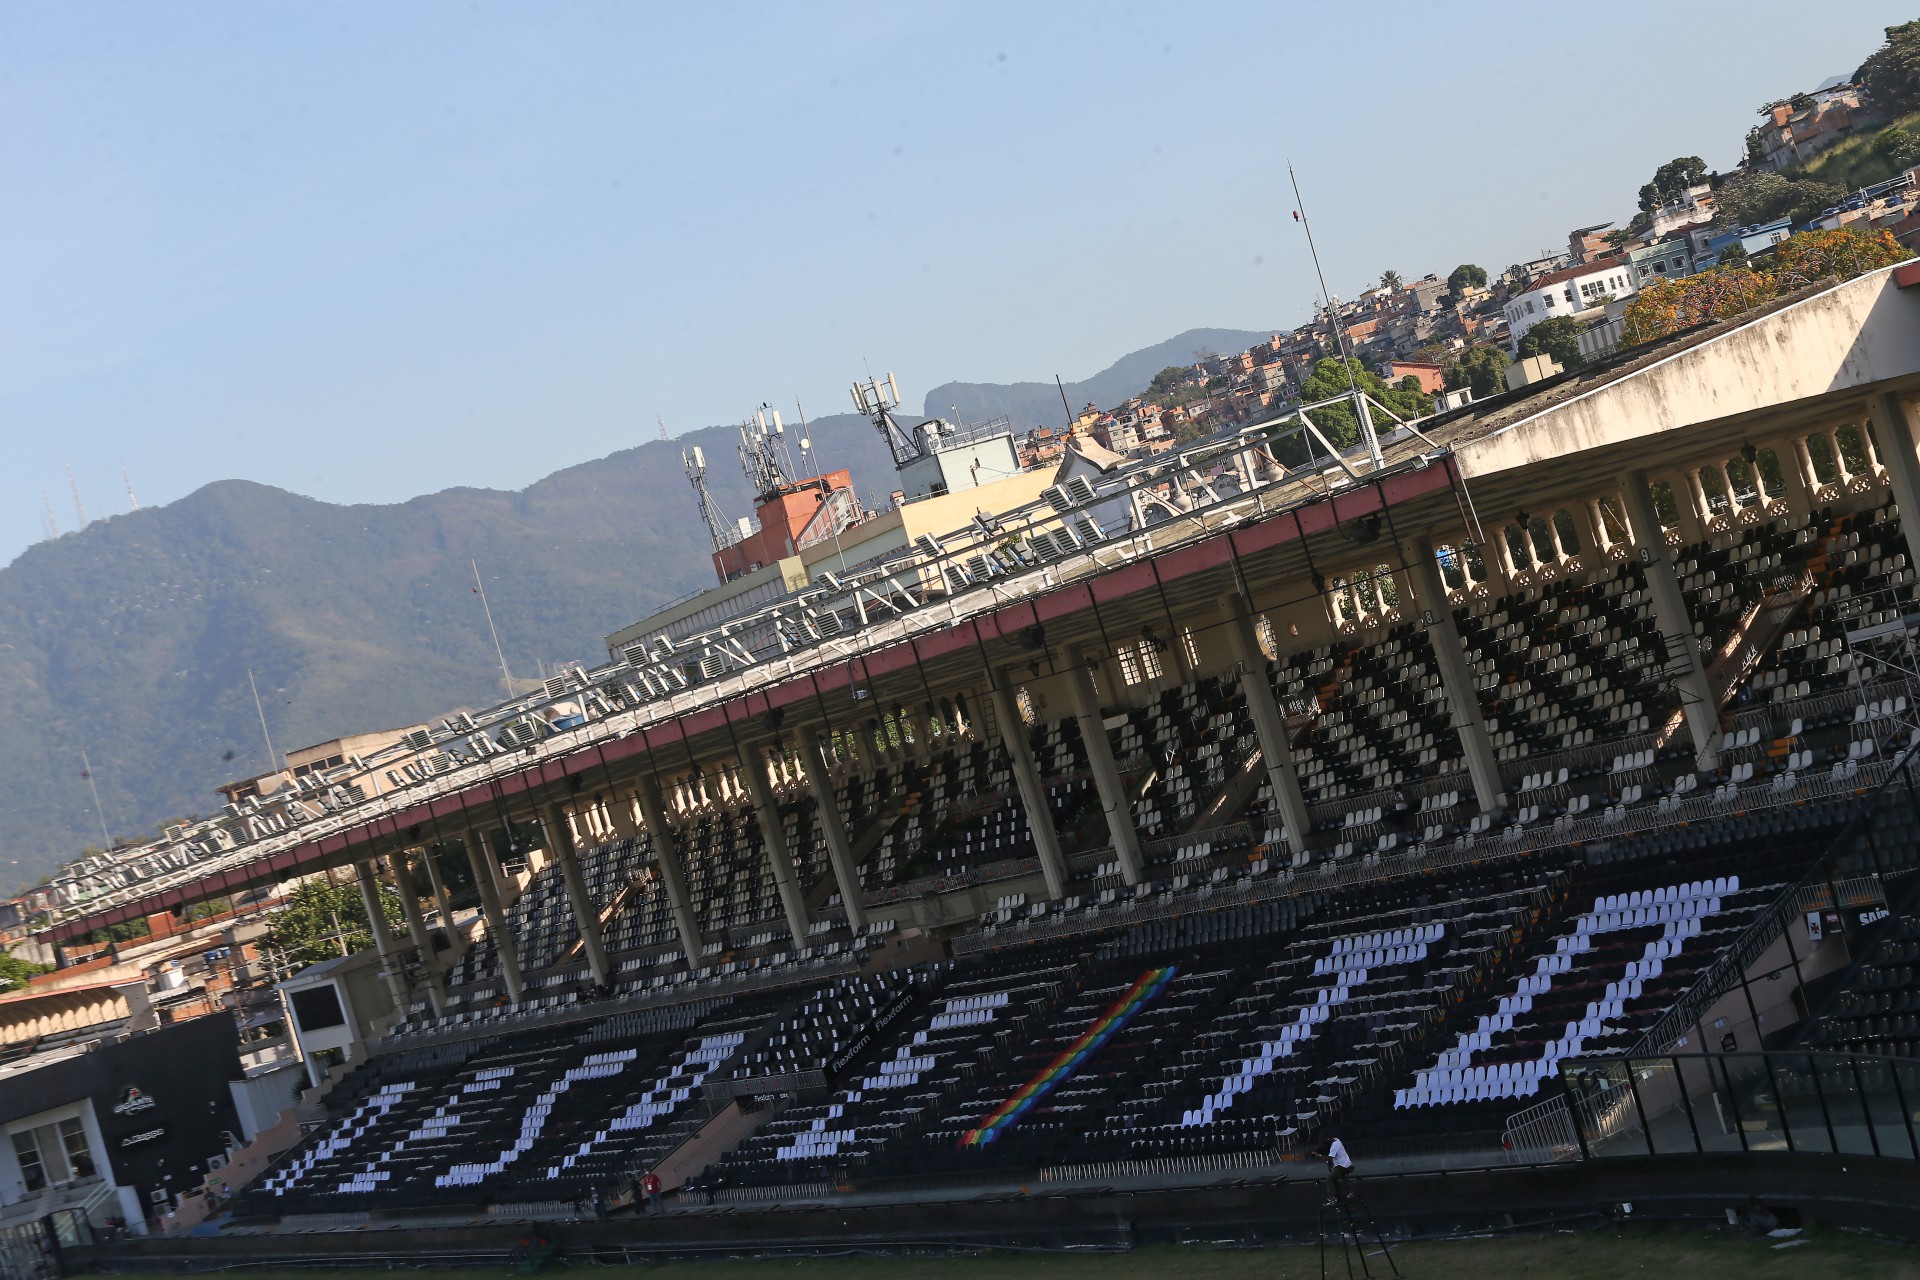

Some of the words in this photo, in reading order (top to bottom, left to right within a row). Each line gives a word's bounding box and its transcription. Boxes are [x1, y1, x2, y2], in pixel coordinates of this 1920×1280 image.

[1640, 549, 1648, 561] 9
[1425, 611, 1433, 624] 8
[832, 1034, 871, 1073] Flexform
[875, 994, 913, 1032] Flexform
